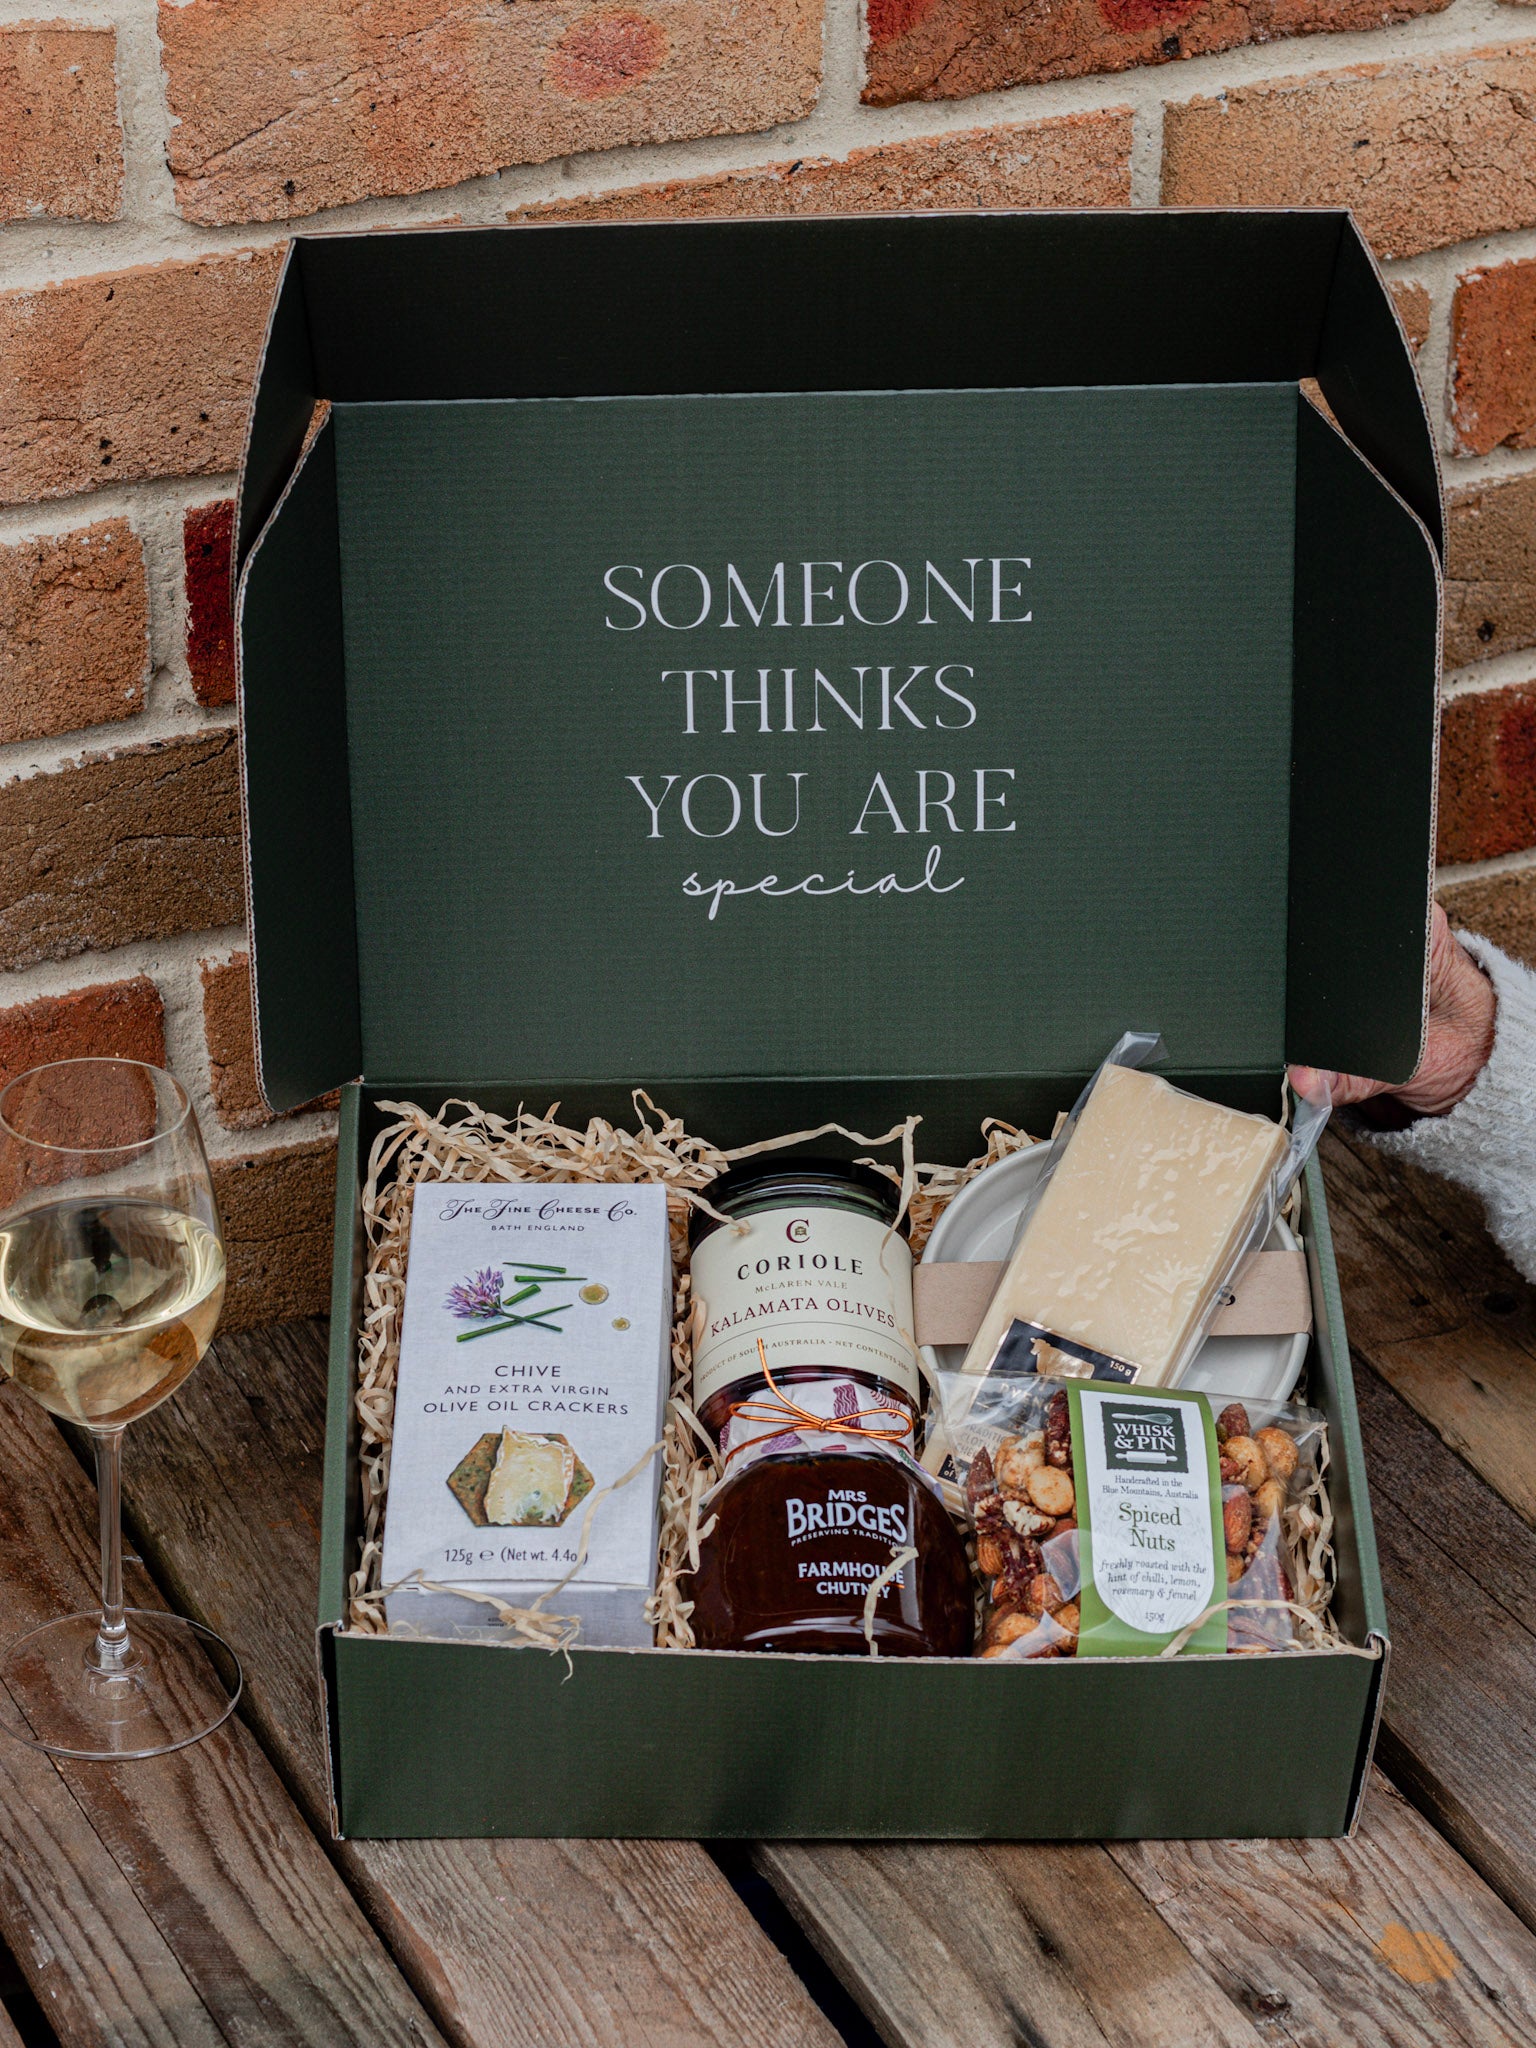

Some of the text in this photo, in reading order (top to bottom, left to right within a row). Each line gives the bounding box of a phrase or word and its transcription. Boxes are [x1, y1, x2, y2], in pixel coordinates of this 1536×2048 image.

[603, 557, 1033, 631] SOMEONE
[661, 664, 977, 734] THINKS
[624, 768, 1017, 838] YOU ARE
[682, 844, 965, 921] special
[528, 1224, 585, 1232] ENGLAND
[785, 1219, 811, 1243] C
[737, 1253, 864, 1280] CORIOLE
[754, 1279, 848, 1294] McLAREN VALE
[711, 1297, 896, 1337] KALAMATA OLIVES
[727, 1353, 737, 1362] OF
[771, 1338, 826, 1349] AUSTRALIA
[835, 1340, 853, 1349] NET
[856, 1343, 897, 1363] CONTENTS
[494, 1365, 562, 1378] CHIVE
[444, 1384, 609, 1396] AND EXTRA VIRGIN
[423, 1400, 629, 1415] OLIVE OIL CRACKERS
[1113, 1423, 1176, 1438] WHISK
[1136, 1435, 1177, 1451] PIN
[1115, 1475, 1183, 1487] Handcrafted in the
[828, 1489, 868, 1502] MRS
[1102, 1485, 1119, 1494] Blue
[1164, 1489, 1199, 1500] Australia
[786, 1498, 907, 1543] BRIDGES
[1119, 1502, 1182, 1527] Spiced
[791, 1528, 901, 1549] PRESERVING TRADITIO
[1128, 1528, 1176, 1551] Nuts
[444, 1548, 473, 1565] 125g
[500, 1546, 528, 1563] (Net
[530, 1550, 548, 1562] wt.
[551, 1548, 588, 1565] 4.4o)
[798, 1562, 905, 1584] FARMHOUE
[1099, 1558, 1207, 1574] freshly roasted with the
[1108, 1572, 1201, 1588] hint of chilli, lemon,
[816, 1581, 890, 1599] CHUTNY
[1112, 1587, 1197, 1601] rosemary & fennel
[1145, 1611, 1165, 1623] 150g
